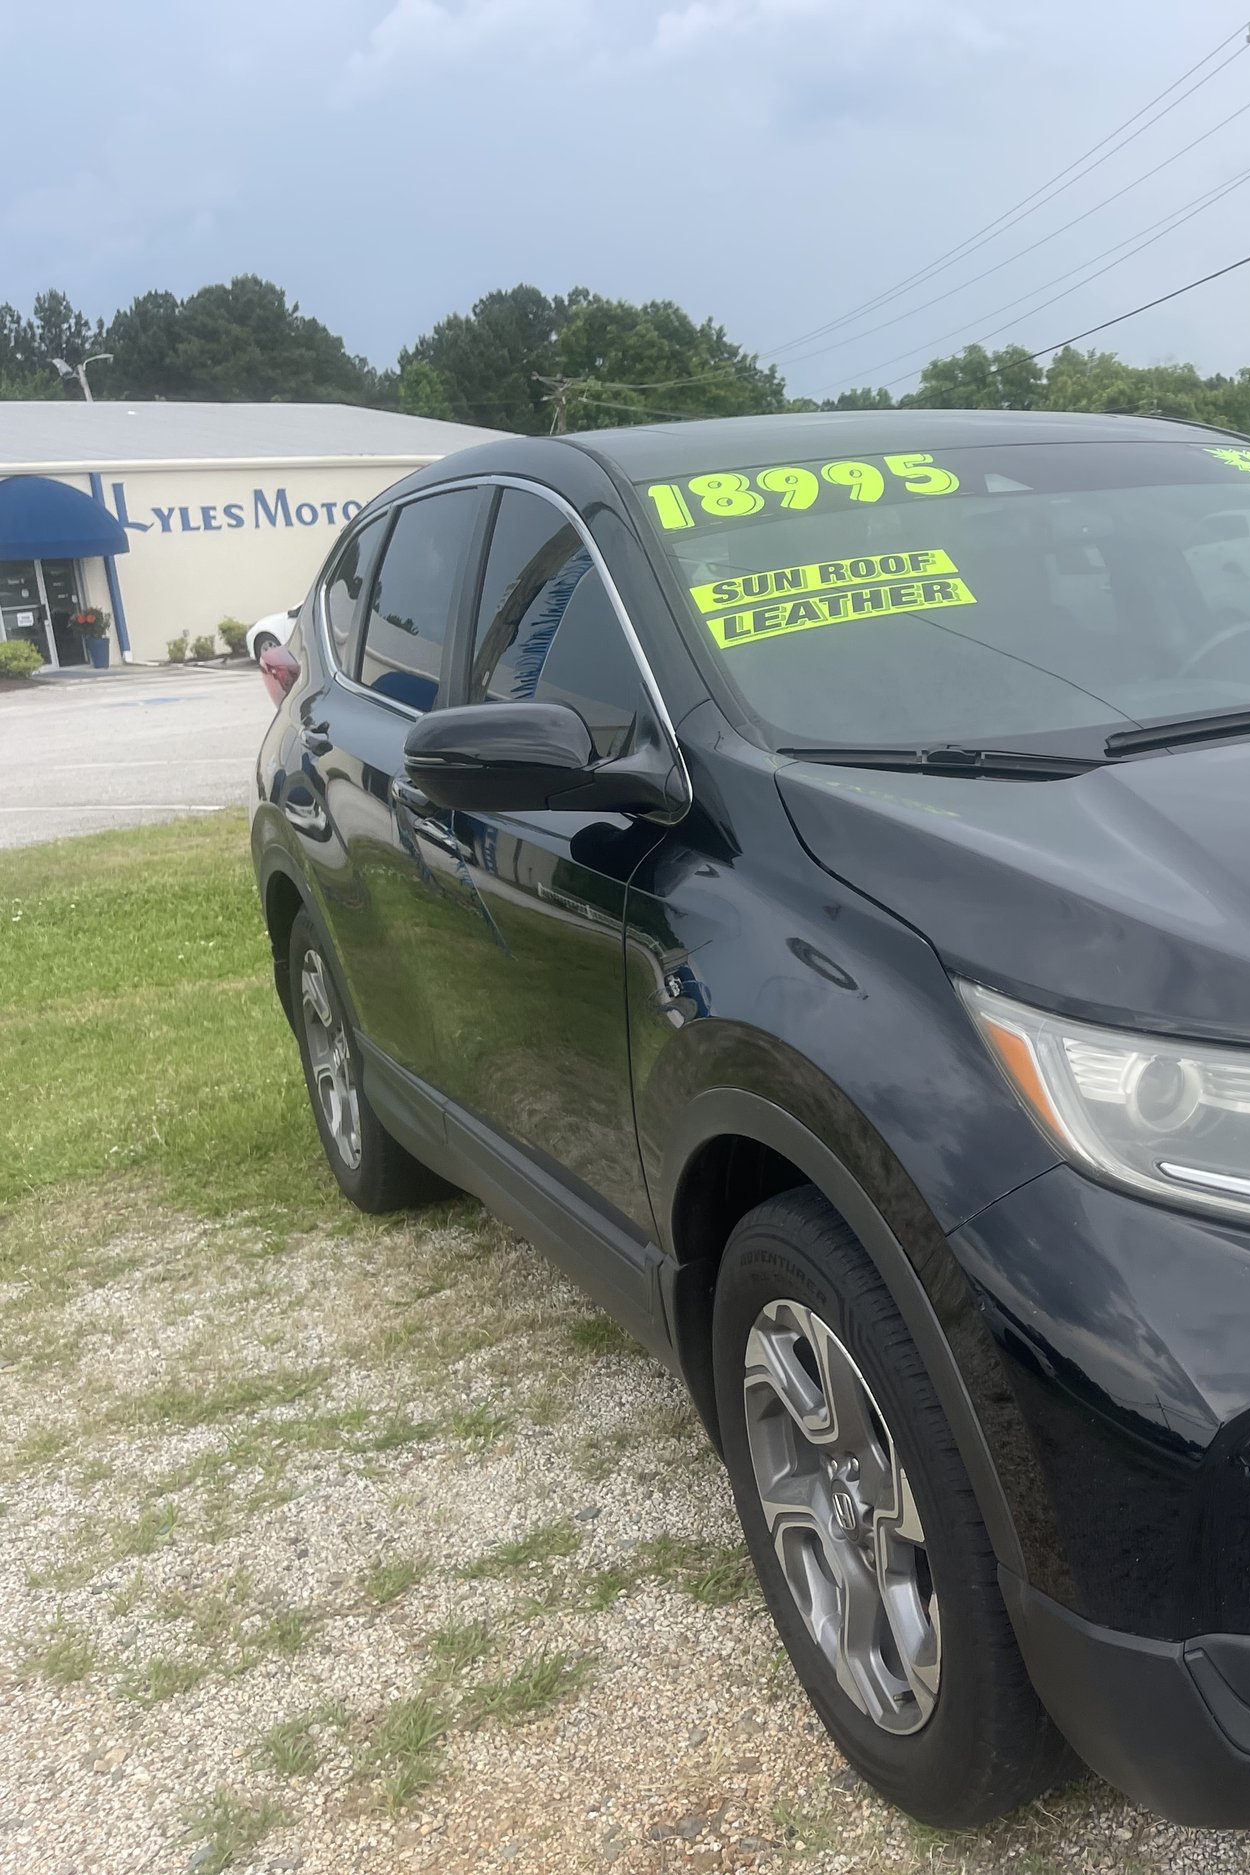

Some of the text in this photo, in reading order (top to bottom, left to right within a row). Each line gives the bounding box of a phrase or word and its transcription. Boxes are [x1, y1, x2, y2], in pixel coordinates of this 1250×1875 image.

[253, 488, 368, 529] MOTO
[648, 453, 960, 529] 18995
[711, 551, 936, 606] SUN ROOF
[723, 580, 960, 642] LEATHER
